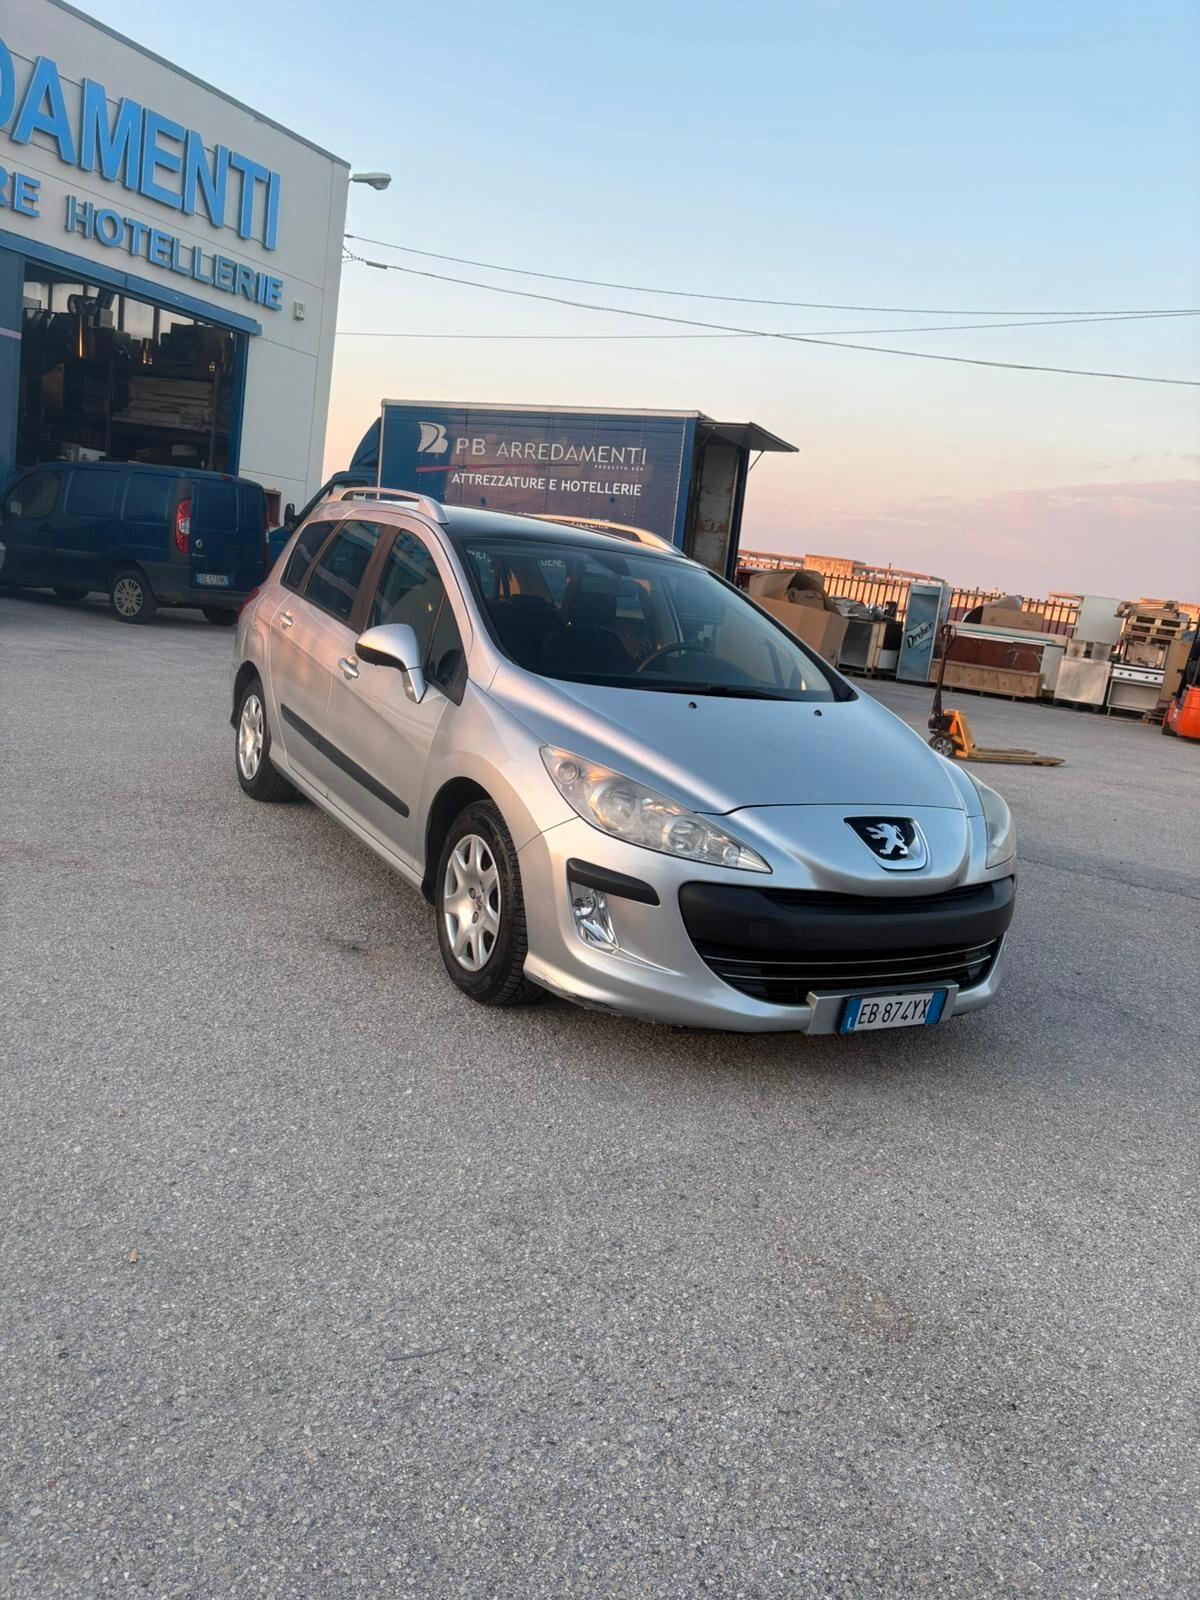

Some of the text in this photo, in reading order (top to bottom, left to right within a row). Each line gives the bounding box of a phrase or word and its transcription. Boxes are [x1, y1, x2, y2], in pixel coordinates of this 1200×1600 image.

[65, 195, 284, 311] HOTELLERIE
[455, 437, 647, 465] PB ARREDAMENTI
[452, 473, 642, 496] ATTREZZATURE E HOTELLERIE
[858, 998, 931, 1025] EB 874YX
